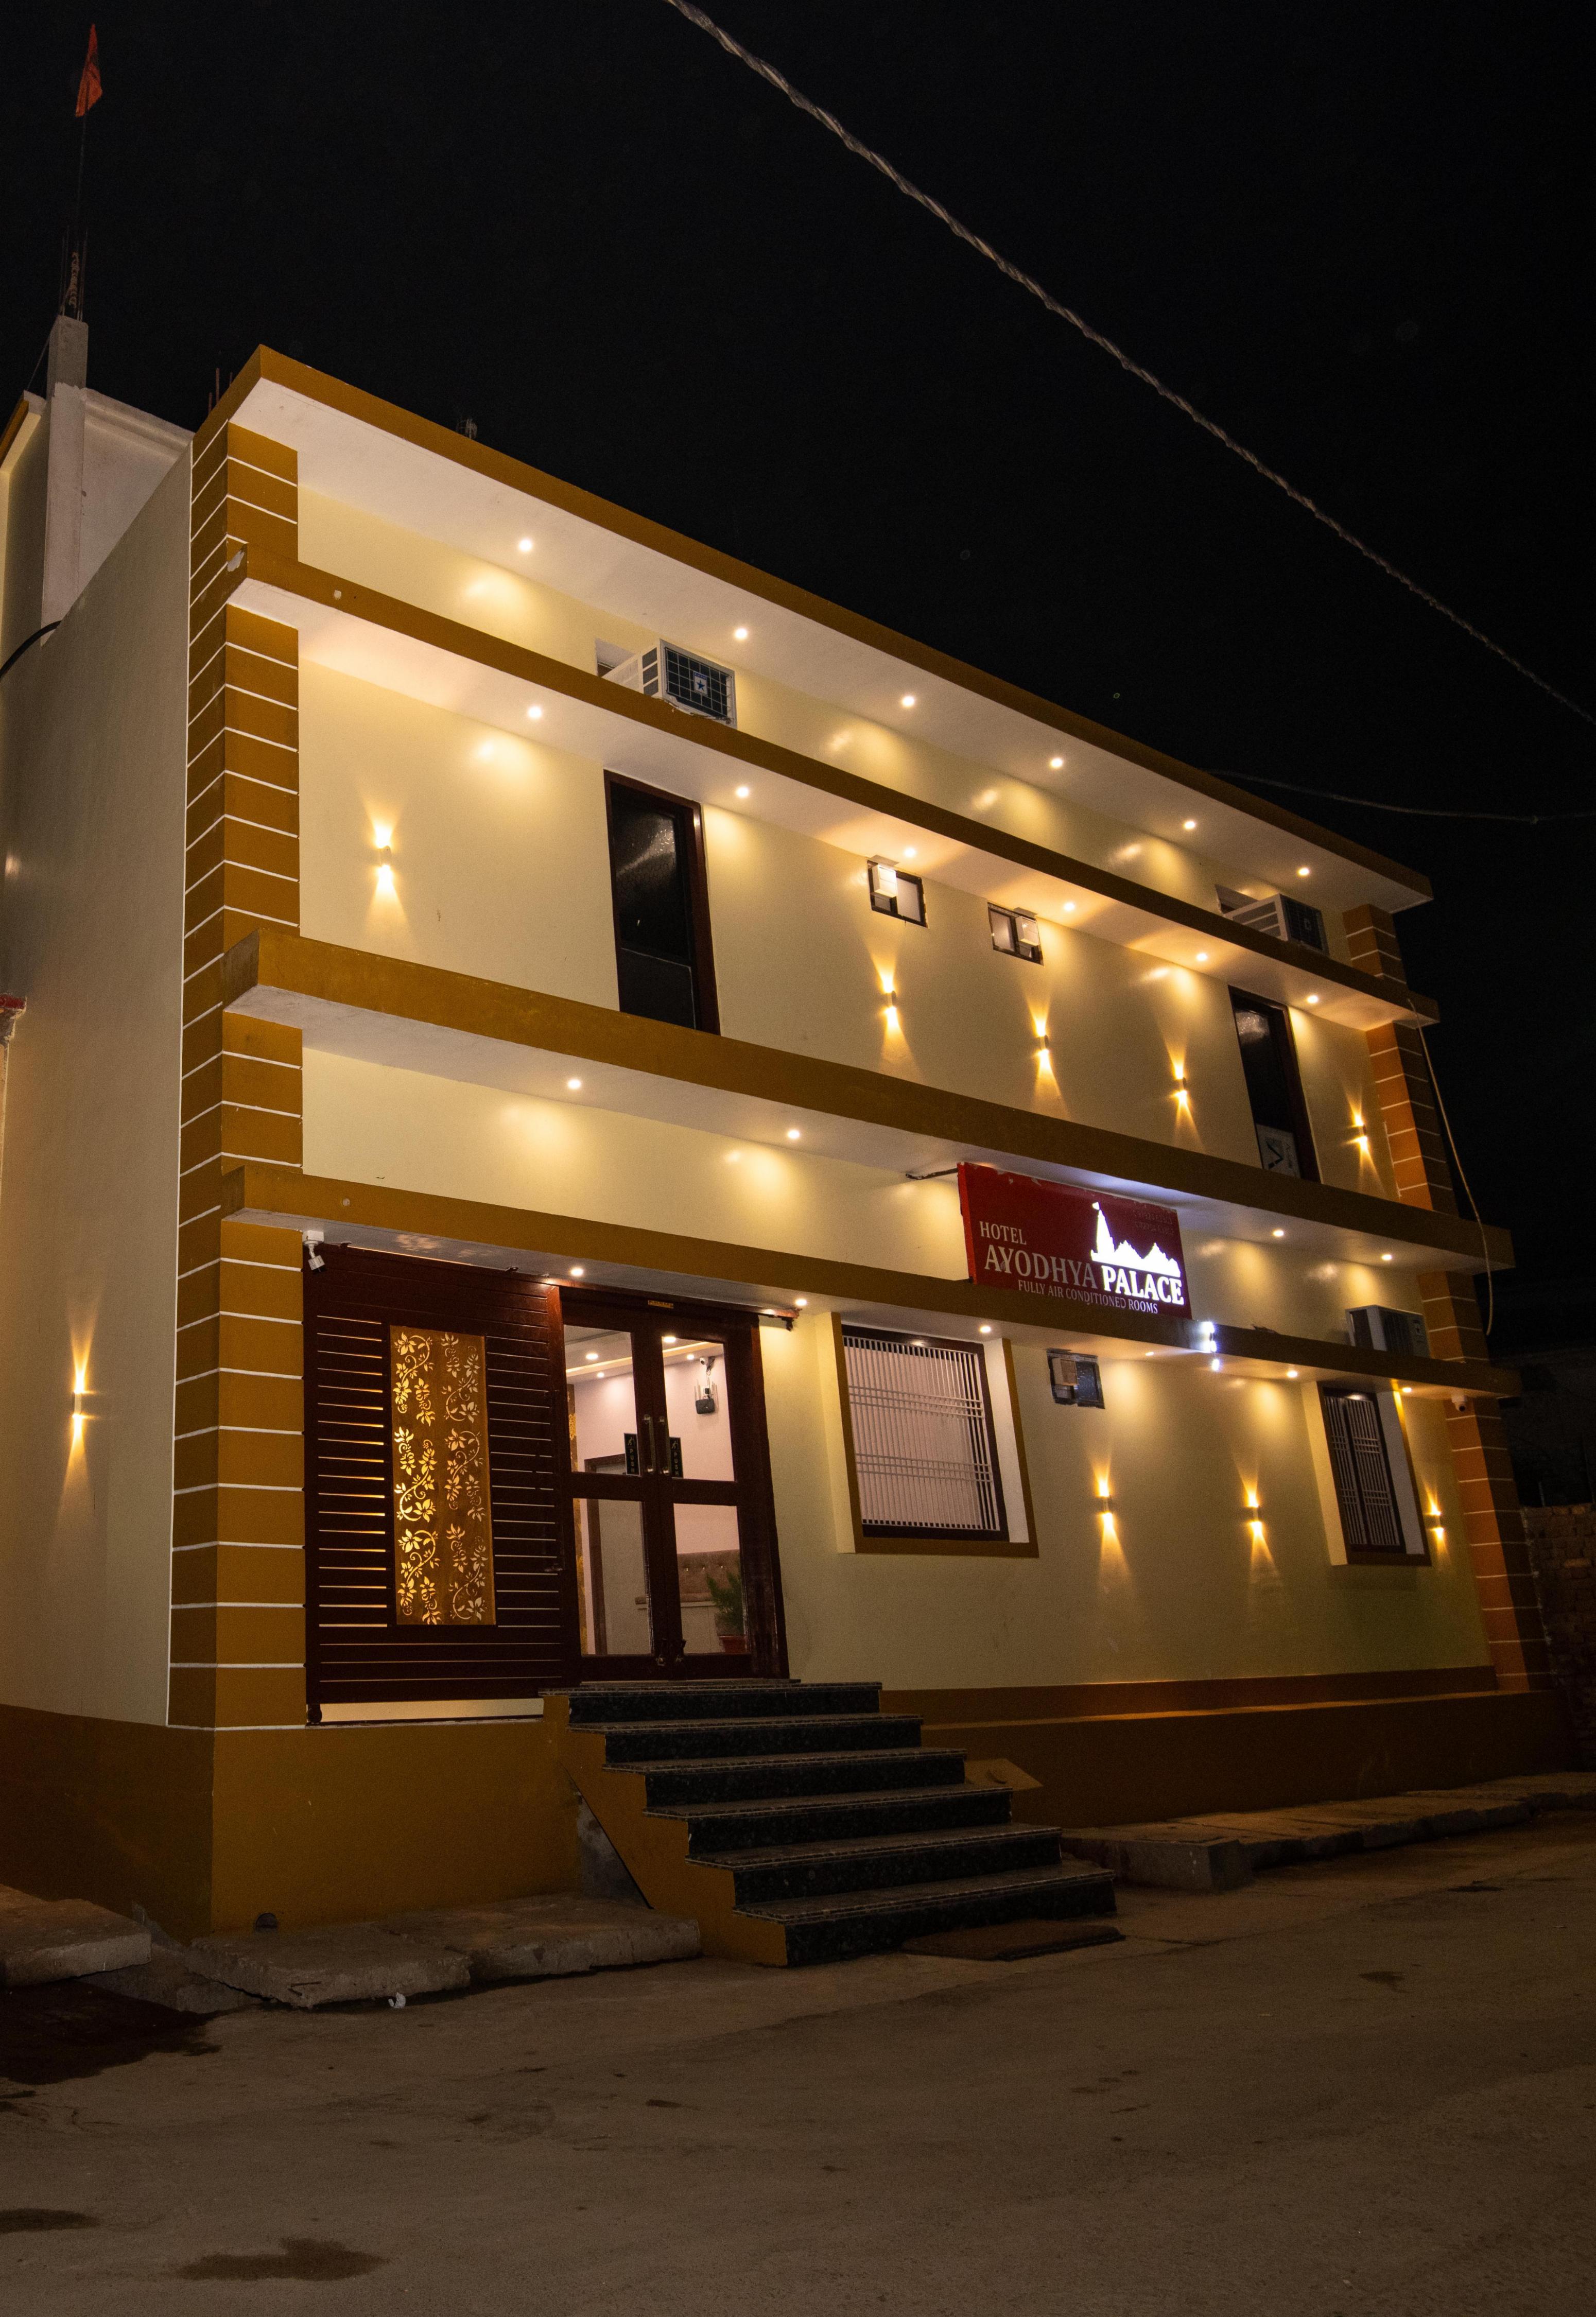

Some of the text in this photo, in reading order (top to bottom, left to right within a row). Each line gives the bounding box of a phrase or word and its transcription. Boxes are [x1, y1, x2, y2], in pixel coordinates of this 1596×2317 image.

[979, 1221, 1027, 1245] HOTEL
[984, 1244, 1185, 1305] AYODHYA PALACE
[1018, 1279, 1158, 1314] FULLY AIR CONDITIONED ROOMS
